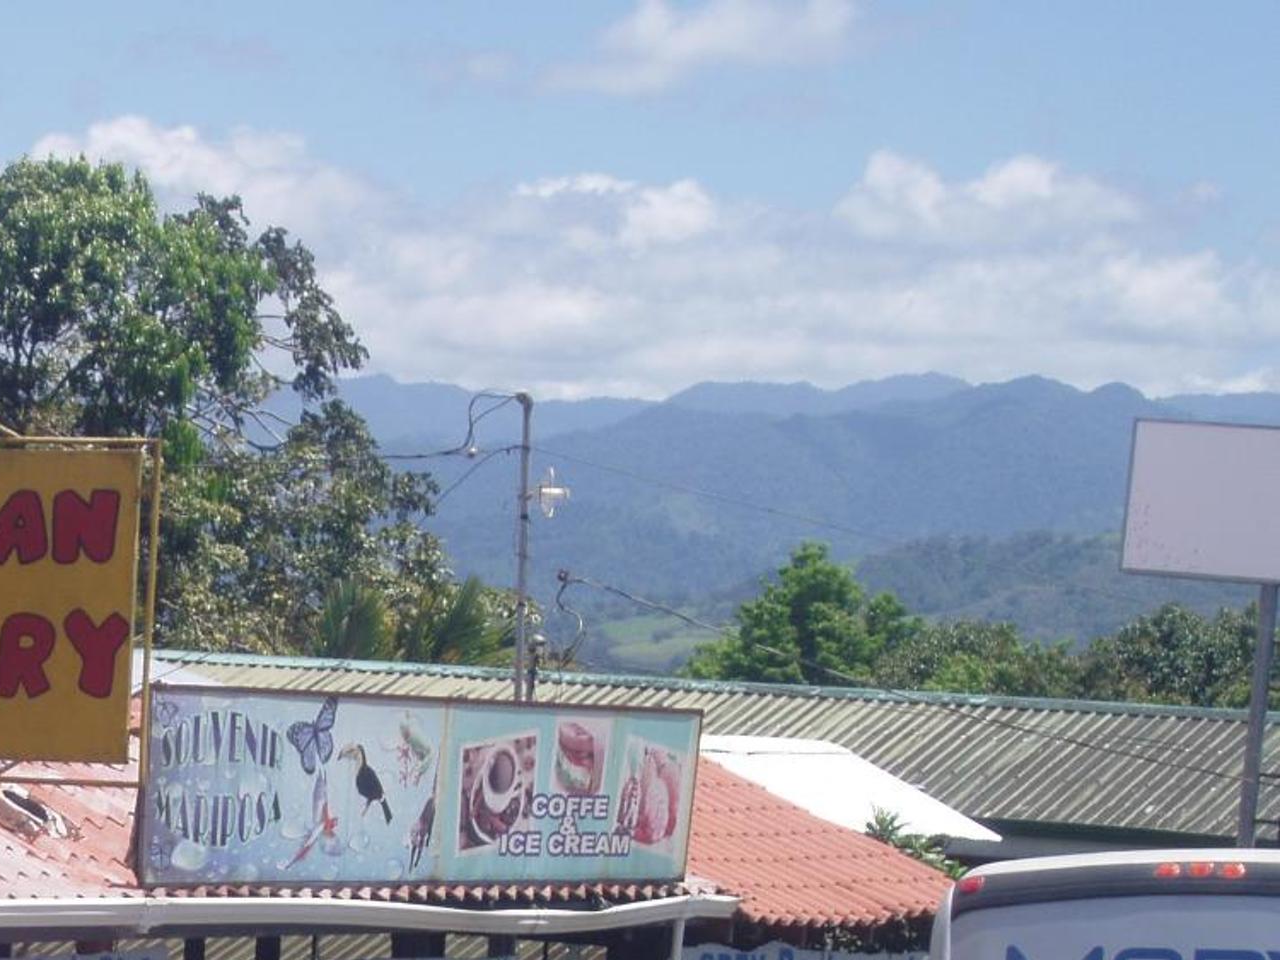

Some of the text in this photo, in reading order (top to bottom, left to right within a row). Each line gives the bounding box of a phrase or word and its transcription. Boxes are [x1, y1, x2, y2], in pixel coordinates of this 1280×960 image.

[160, 711, 284, 771] SOUVENIR
[154, 786, 282, 847] MARIPOSA
[531, 793, 610, 820] COFFE
[559, 815, 578, 836] &
[498, 831, 631, 857] ICE CREAM
